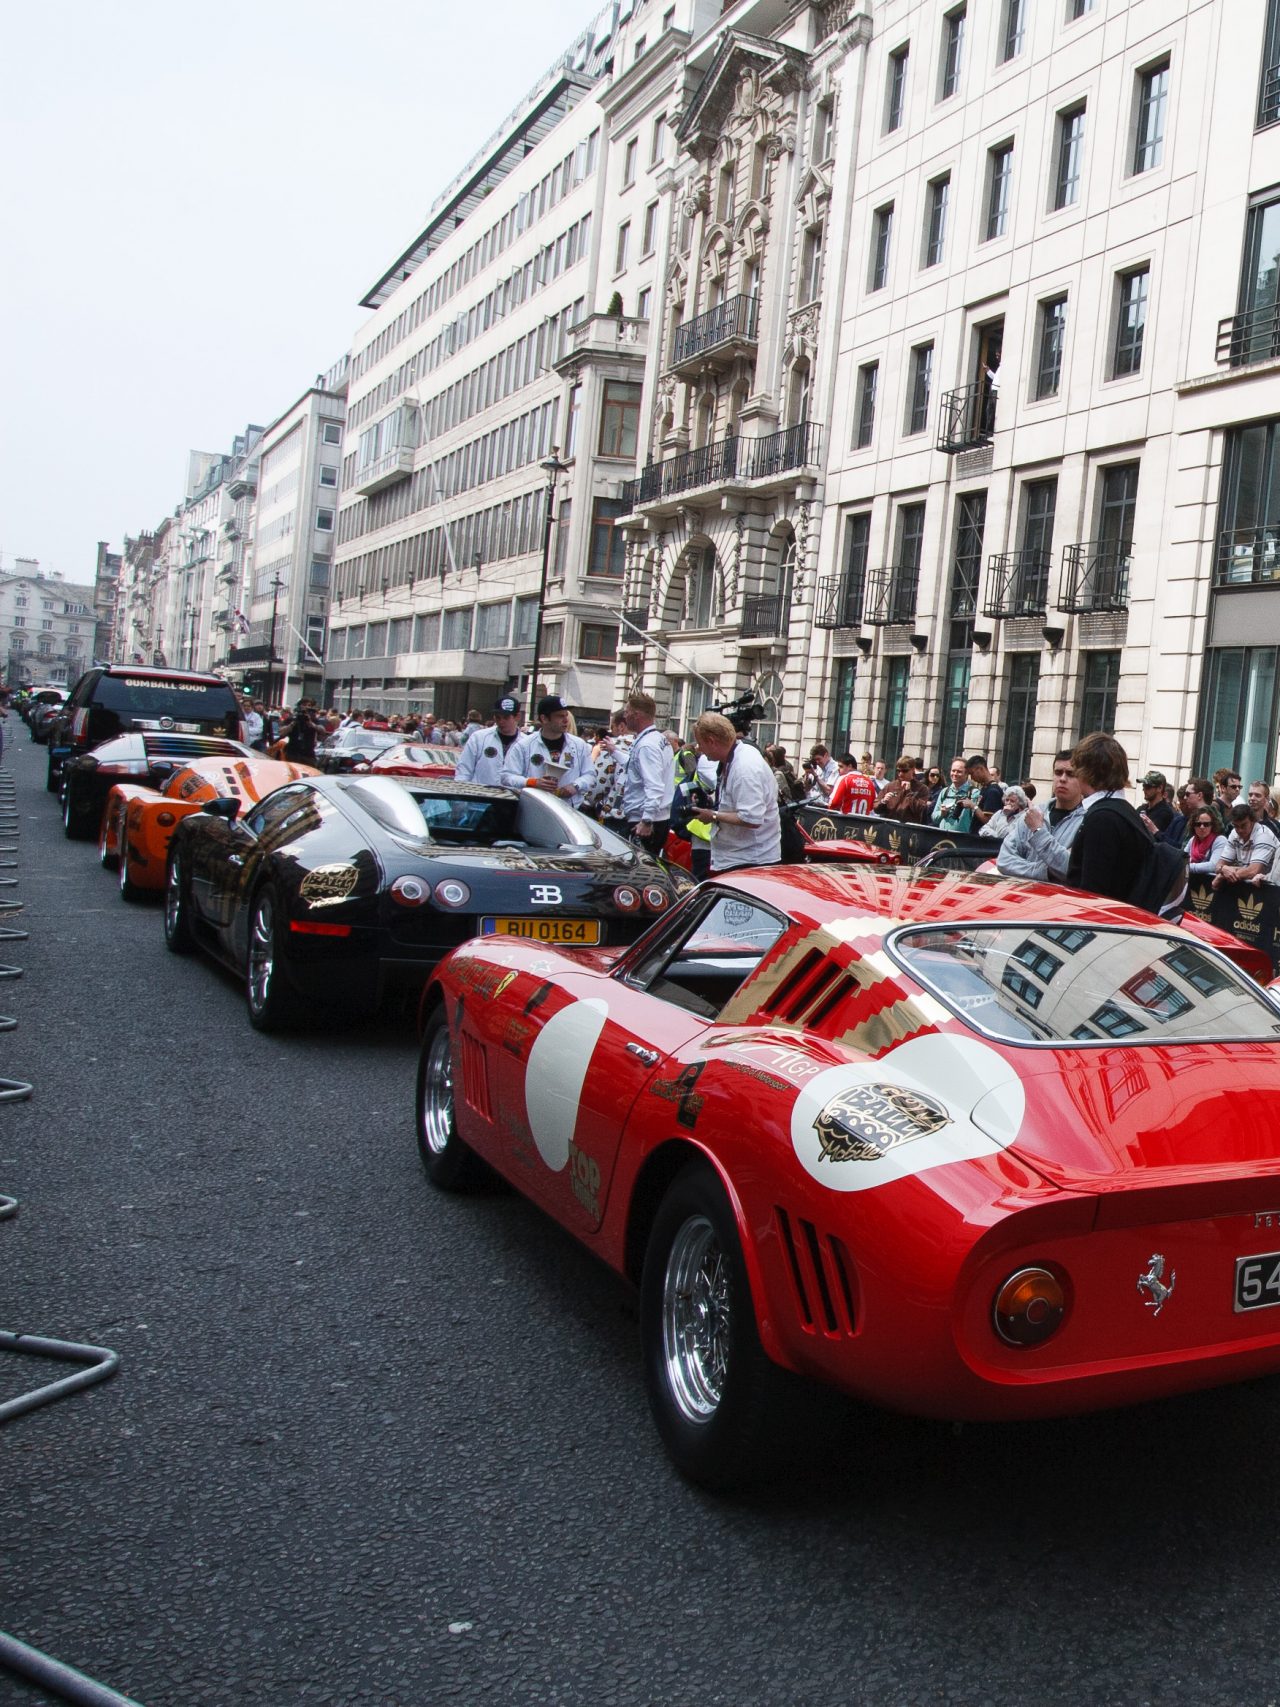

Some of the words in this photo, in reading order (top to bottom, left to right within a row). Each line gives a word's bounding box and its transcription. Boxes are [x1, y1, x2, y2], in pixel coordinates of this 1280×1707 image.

[178, 684, 207, 693] 3000
[539, 922, 586, 940] 0164
[1233, 919, 1260, 933] adidas
